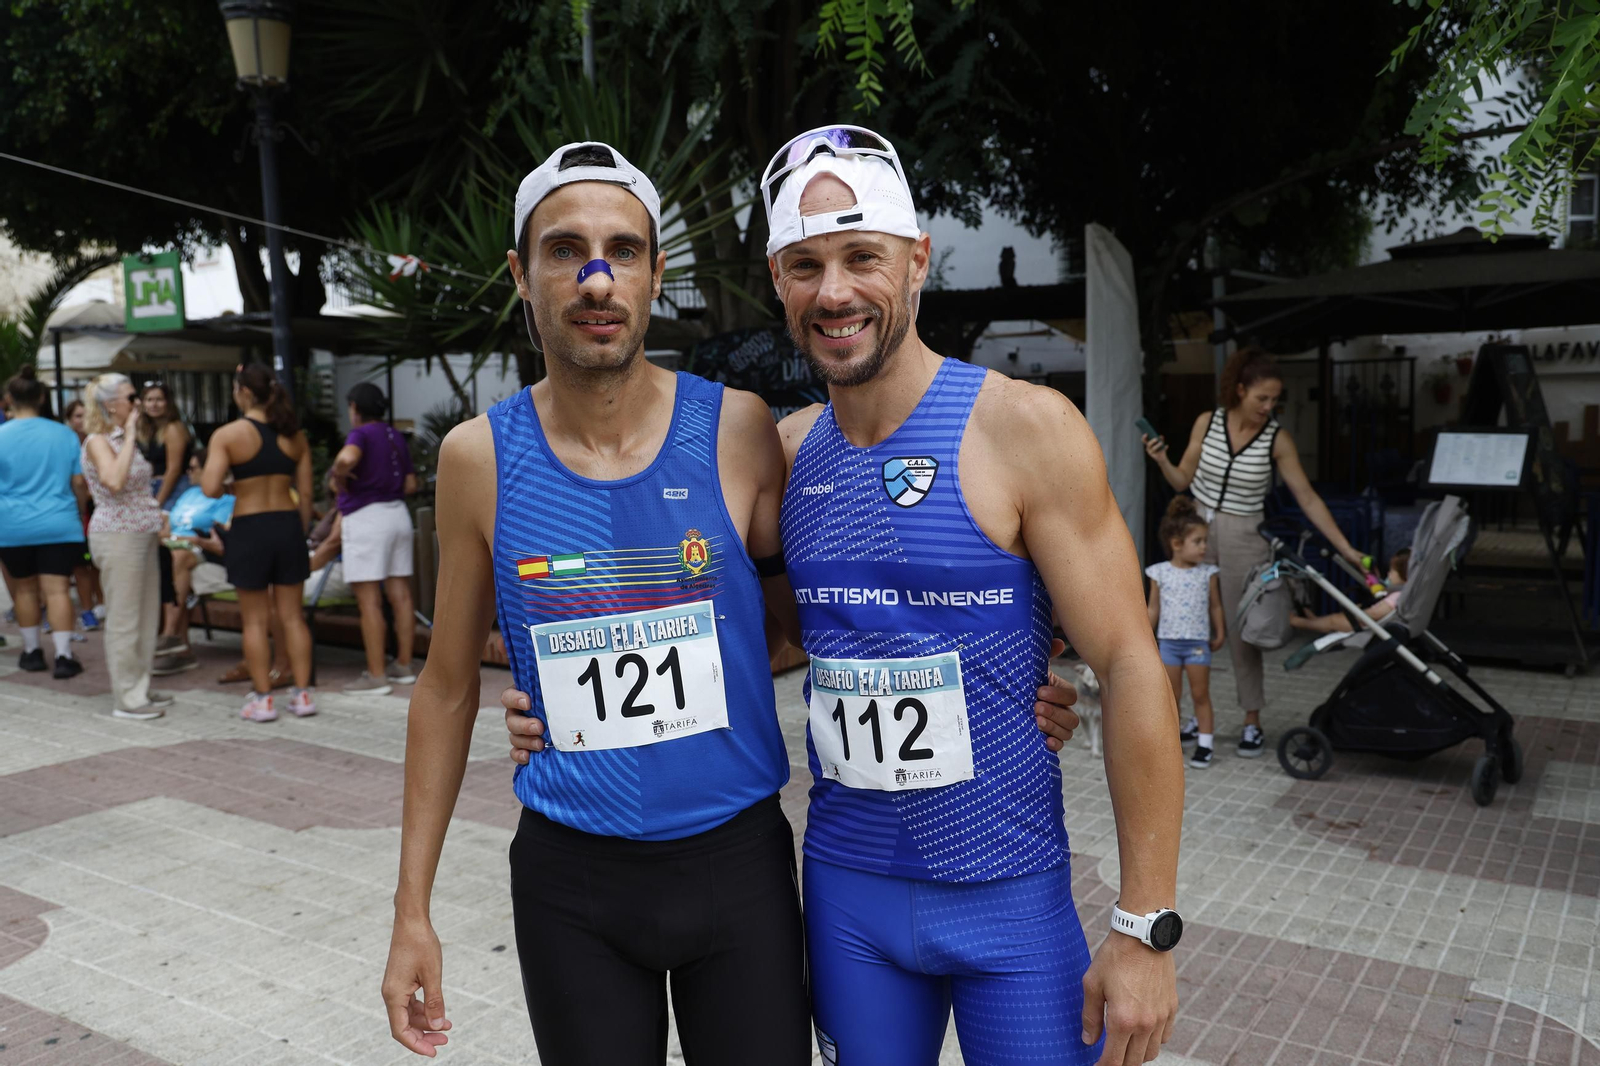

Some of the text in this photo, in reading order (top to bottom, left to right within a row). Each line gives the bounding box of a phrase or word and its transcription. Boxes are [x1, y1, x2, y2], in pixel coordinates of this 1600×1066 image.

[802, 482, 834, 496] mobel
[795, 587, 1014, 606] ATLETISMO LINENSE
[548, 615, 699, 654] DESAFÍO ELA TARIFA
[577, 646, 686, 722] 121
[816, 667, 944, 697] DESAFÍO ELA TARIFA
[664, 718, 698, 731] TARIFA
[832, 697, 934, 763] 112
[907, 770, 942, 780] TARIFA
